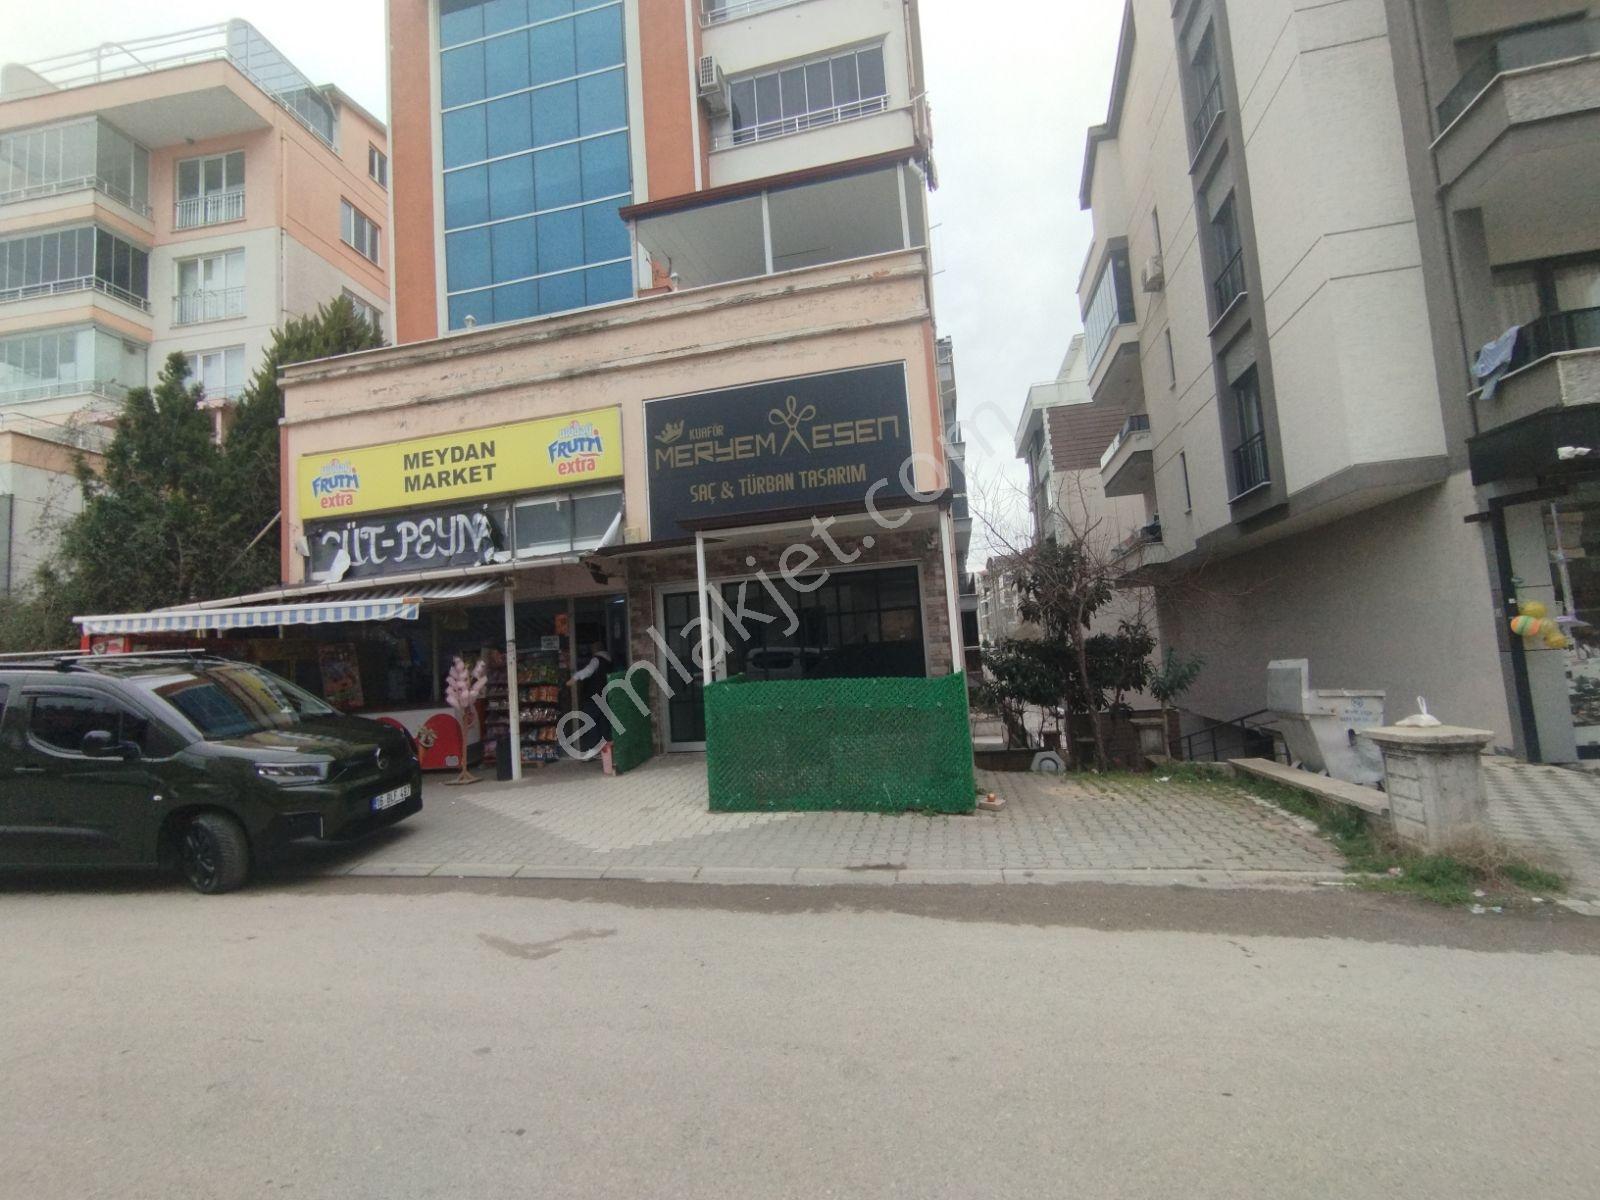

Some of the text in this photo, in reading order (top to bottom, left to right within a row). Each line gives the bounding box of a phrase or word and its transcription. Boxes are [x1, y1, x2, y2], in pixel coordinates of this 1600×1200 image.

[403, 441, 495, 470] MEYDAN
[655, 415, 899, 470] MERYEM ESEN
[404, 463, 496, 493] MARKET
[558, 457, 596, 475] extra
[689, 463, 867, 504] SAÇ & TÜRBAN TASARIM
[320, 493, 353, 508] extra
